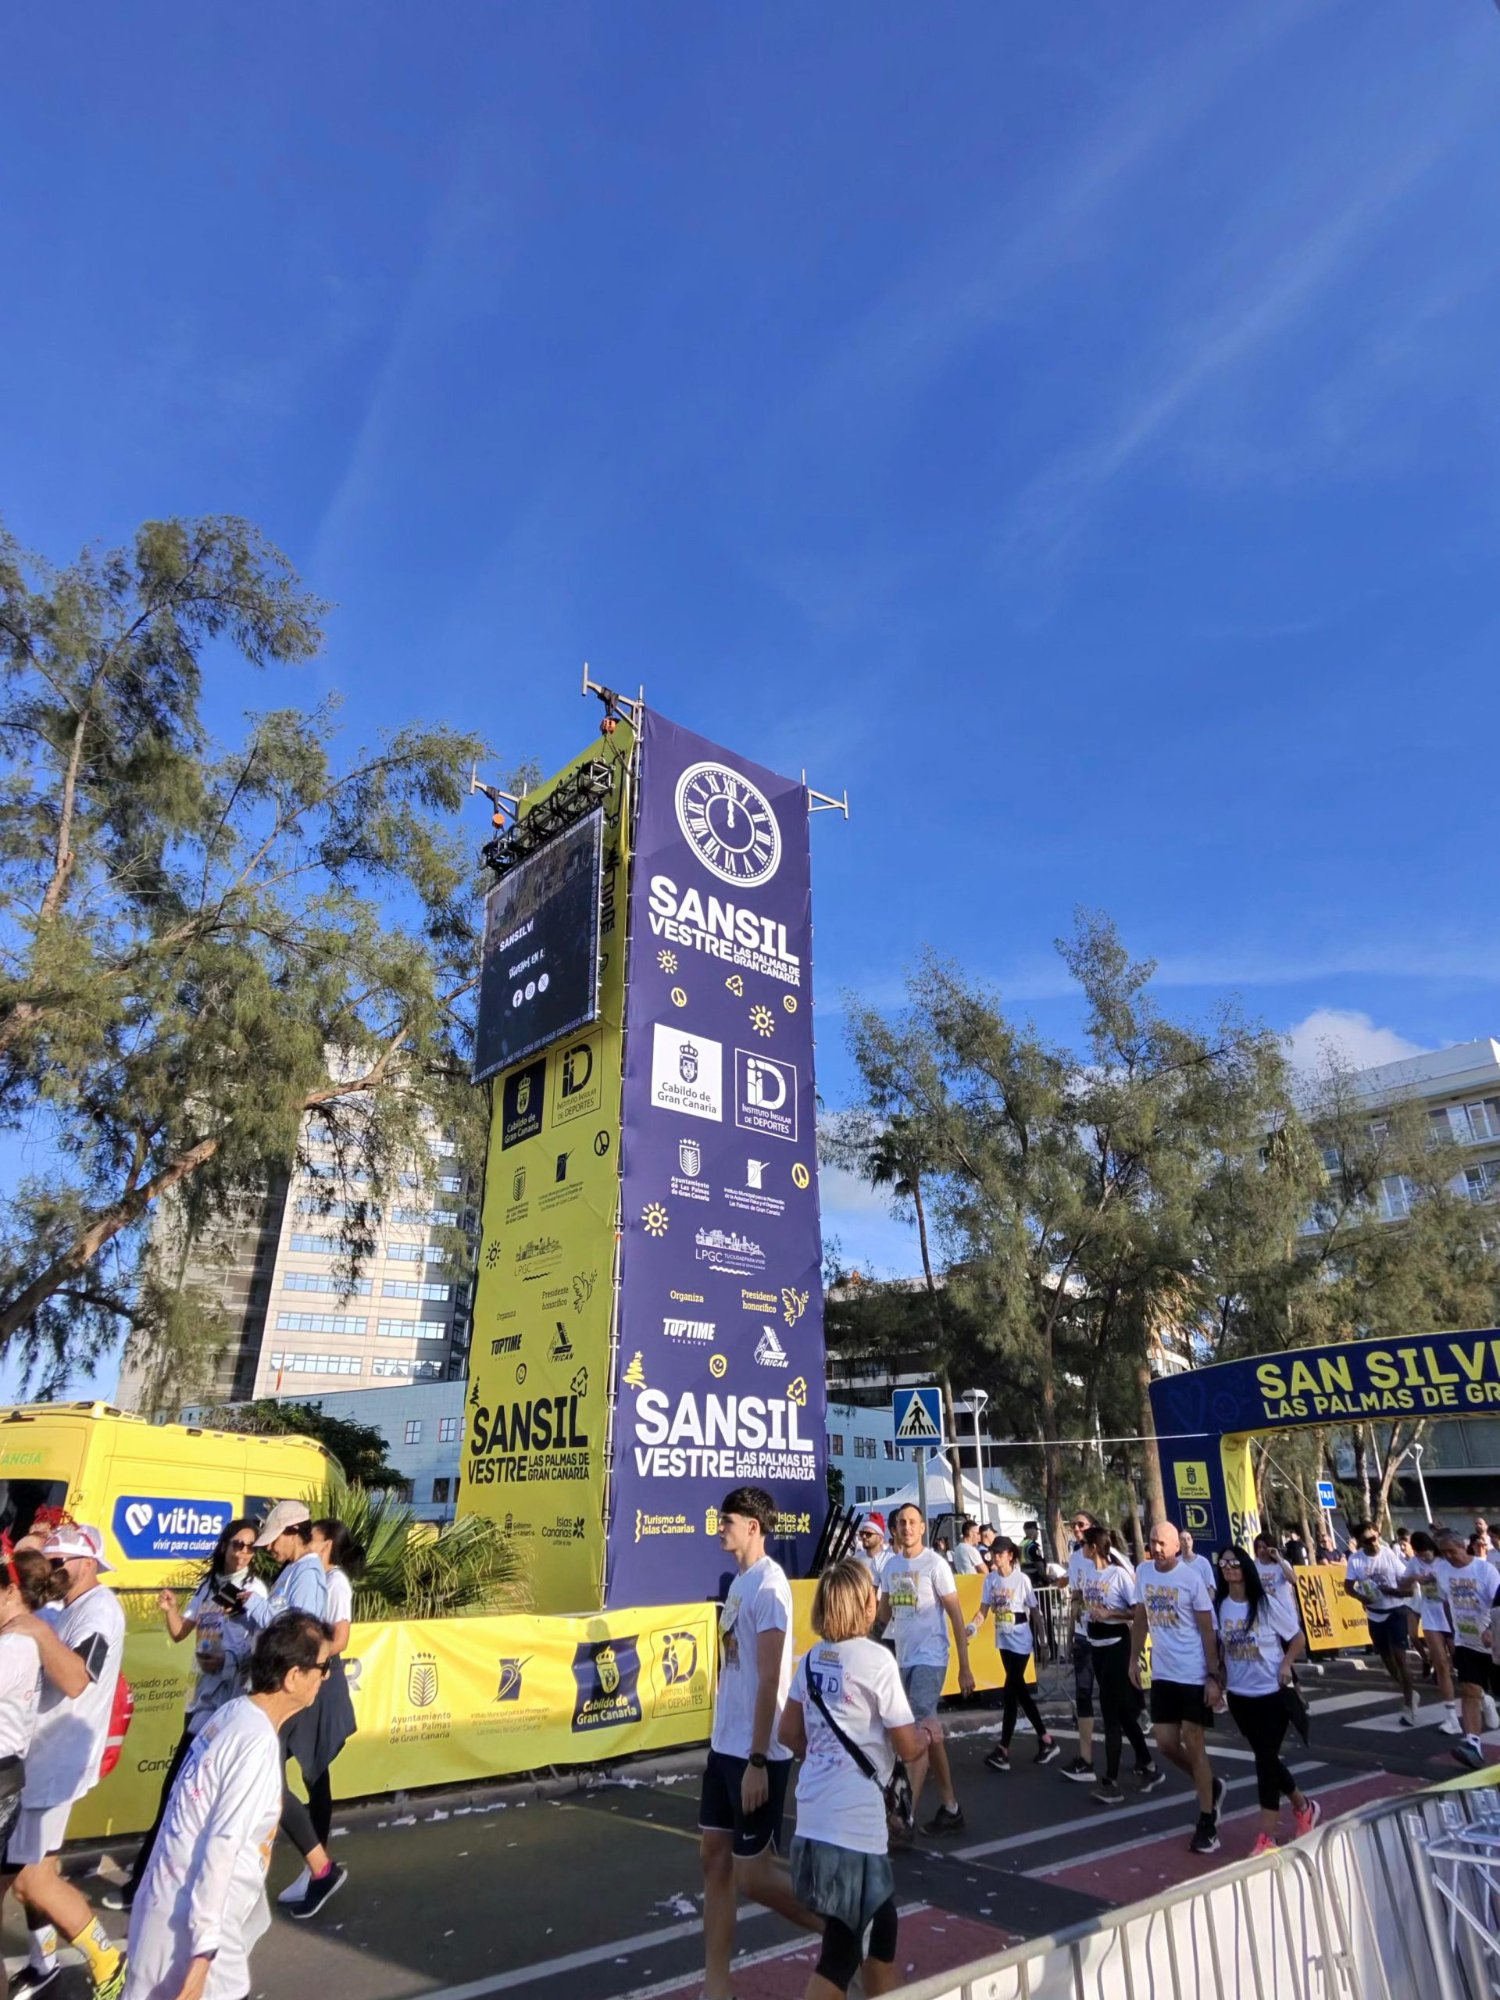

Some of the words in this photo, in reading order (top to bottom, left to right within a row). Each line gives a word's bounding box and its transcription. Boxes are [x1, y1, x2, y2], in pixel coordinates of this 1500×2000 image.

[648, 875, 800, 966] SANSIL
[648, 912, 733, 962] VESTRE
[734, 945, 751, 958] LAS
[753, 951, 788, 972] PALMAS
[788, 966, 800, 977] DE
[734, 955, 759, 972] GRAN
[760, 964, 800, 987] CANARIA
[662, 1082, 698, 1098] Cabildo
[700, 1091, 711, 1102] de
[658, 1091, 680, 1105] Gran
[682, 1097, 717, 1114] Canaria
[507, 1116, 527, 1133] Cabildo
[528, 1112, 536, 1122] de
[754, 1116, 790, 1134] DEPORTES
[504, 1132, 517, 1144] Gran
[518, 1122, 540, 1137] Canaria
[671, 1176, 710, 1190] Ayuntamiento
[680, 1182, 690, 1191] Las
[691, 1184, 710, 1196] Palmas
[696, 1248, 724, 1263] LPGC
[670, 1290, 704, 1304] Organiza
[741, 1289, 778, 1302] Presidente
[760, 1358, 790, 1368] TRICAN
[1256, 1355, 1354, 1399] SAN
[1264, 1397, 1308, 1419] LAS
[1313, 1388, 1415, 1415] PALMAS
[1420, 1385, 1459, 1407] DE
[471, 1394, 588, 1456] SANSIL
[635, 1388, 814, 1452] SANSIL
[528, 1456, 544, 1468] LAS
[545, 1454, 578, 1466] PALMAS
[579, 1452, 590, 1466] DE
[634, 1447, 734, 1478] VESTRE
[736, 1452, 757, 1464] LAS
[761, 1452, 800, 1467] PALMAS
[802, 1455, 816, 1468] DE
[468, 1456, 528, 1484] VESTRE
[528, 1468, 550, 1481] GRAN
[551, 1466, 590, 1480] CANARIA
[736, 1465, 766, 1478] GRAN
[768, 1466, 816, 1480] CANARIA
[1320, 1490, 1334, 1500] TAXI
[158, 1508, 223, 1534] vithas
[556, 1516, 572, 1526] Islas
[643, 1514, 674, 1524] Turismo
[676, 1514, 686, 1524] de
[778, 1512, 797, 1523] Islas
[1232, 1508, 1258, 1537] SAN
[542, 1526, 572, 1538] Canarias
[642, 1525, 660, 1534] Islas
[662, 1524, 695, 1534] Canarias
[170, 1540, 188, 1553] para
[1300, 1574, 1326, 1600] SAN
[164, 1677, 179, 1689] por
[583, 1696, 614, 1712] Cabildo
[616, 1694, 628, 1706] de
[668, 1694, 703, 1710] DEPORTES
[392, 1712, 451, 1724] Ayuntamiento
[576, 1712, 599, 1725] Gran
[600, 1706, 637, 1721] Canaria
[390, 1726, 400, 1734] de
[404, 1724, 418, 1733] Las
[422, 1722, 450, 1730] Palmas
[390, 1734, 399, 1744] de
[400, 1734, 419, 1743] Gran
[420, 1732, 450, 1740] Canaria
